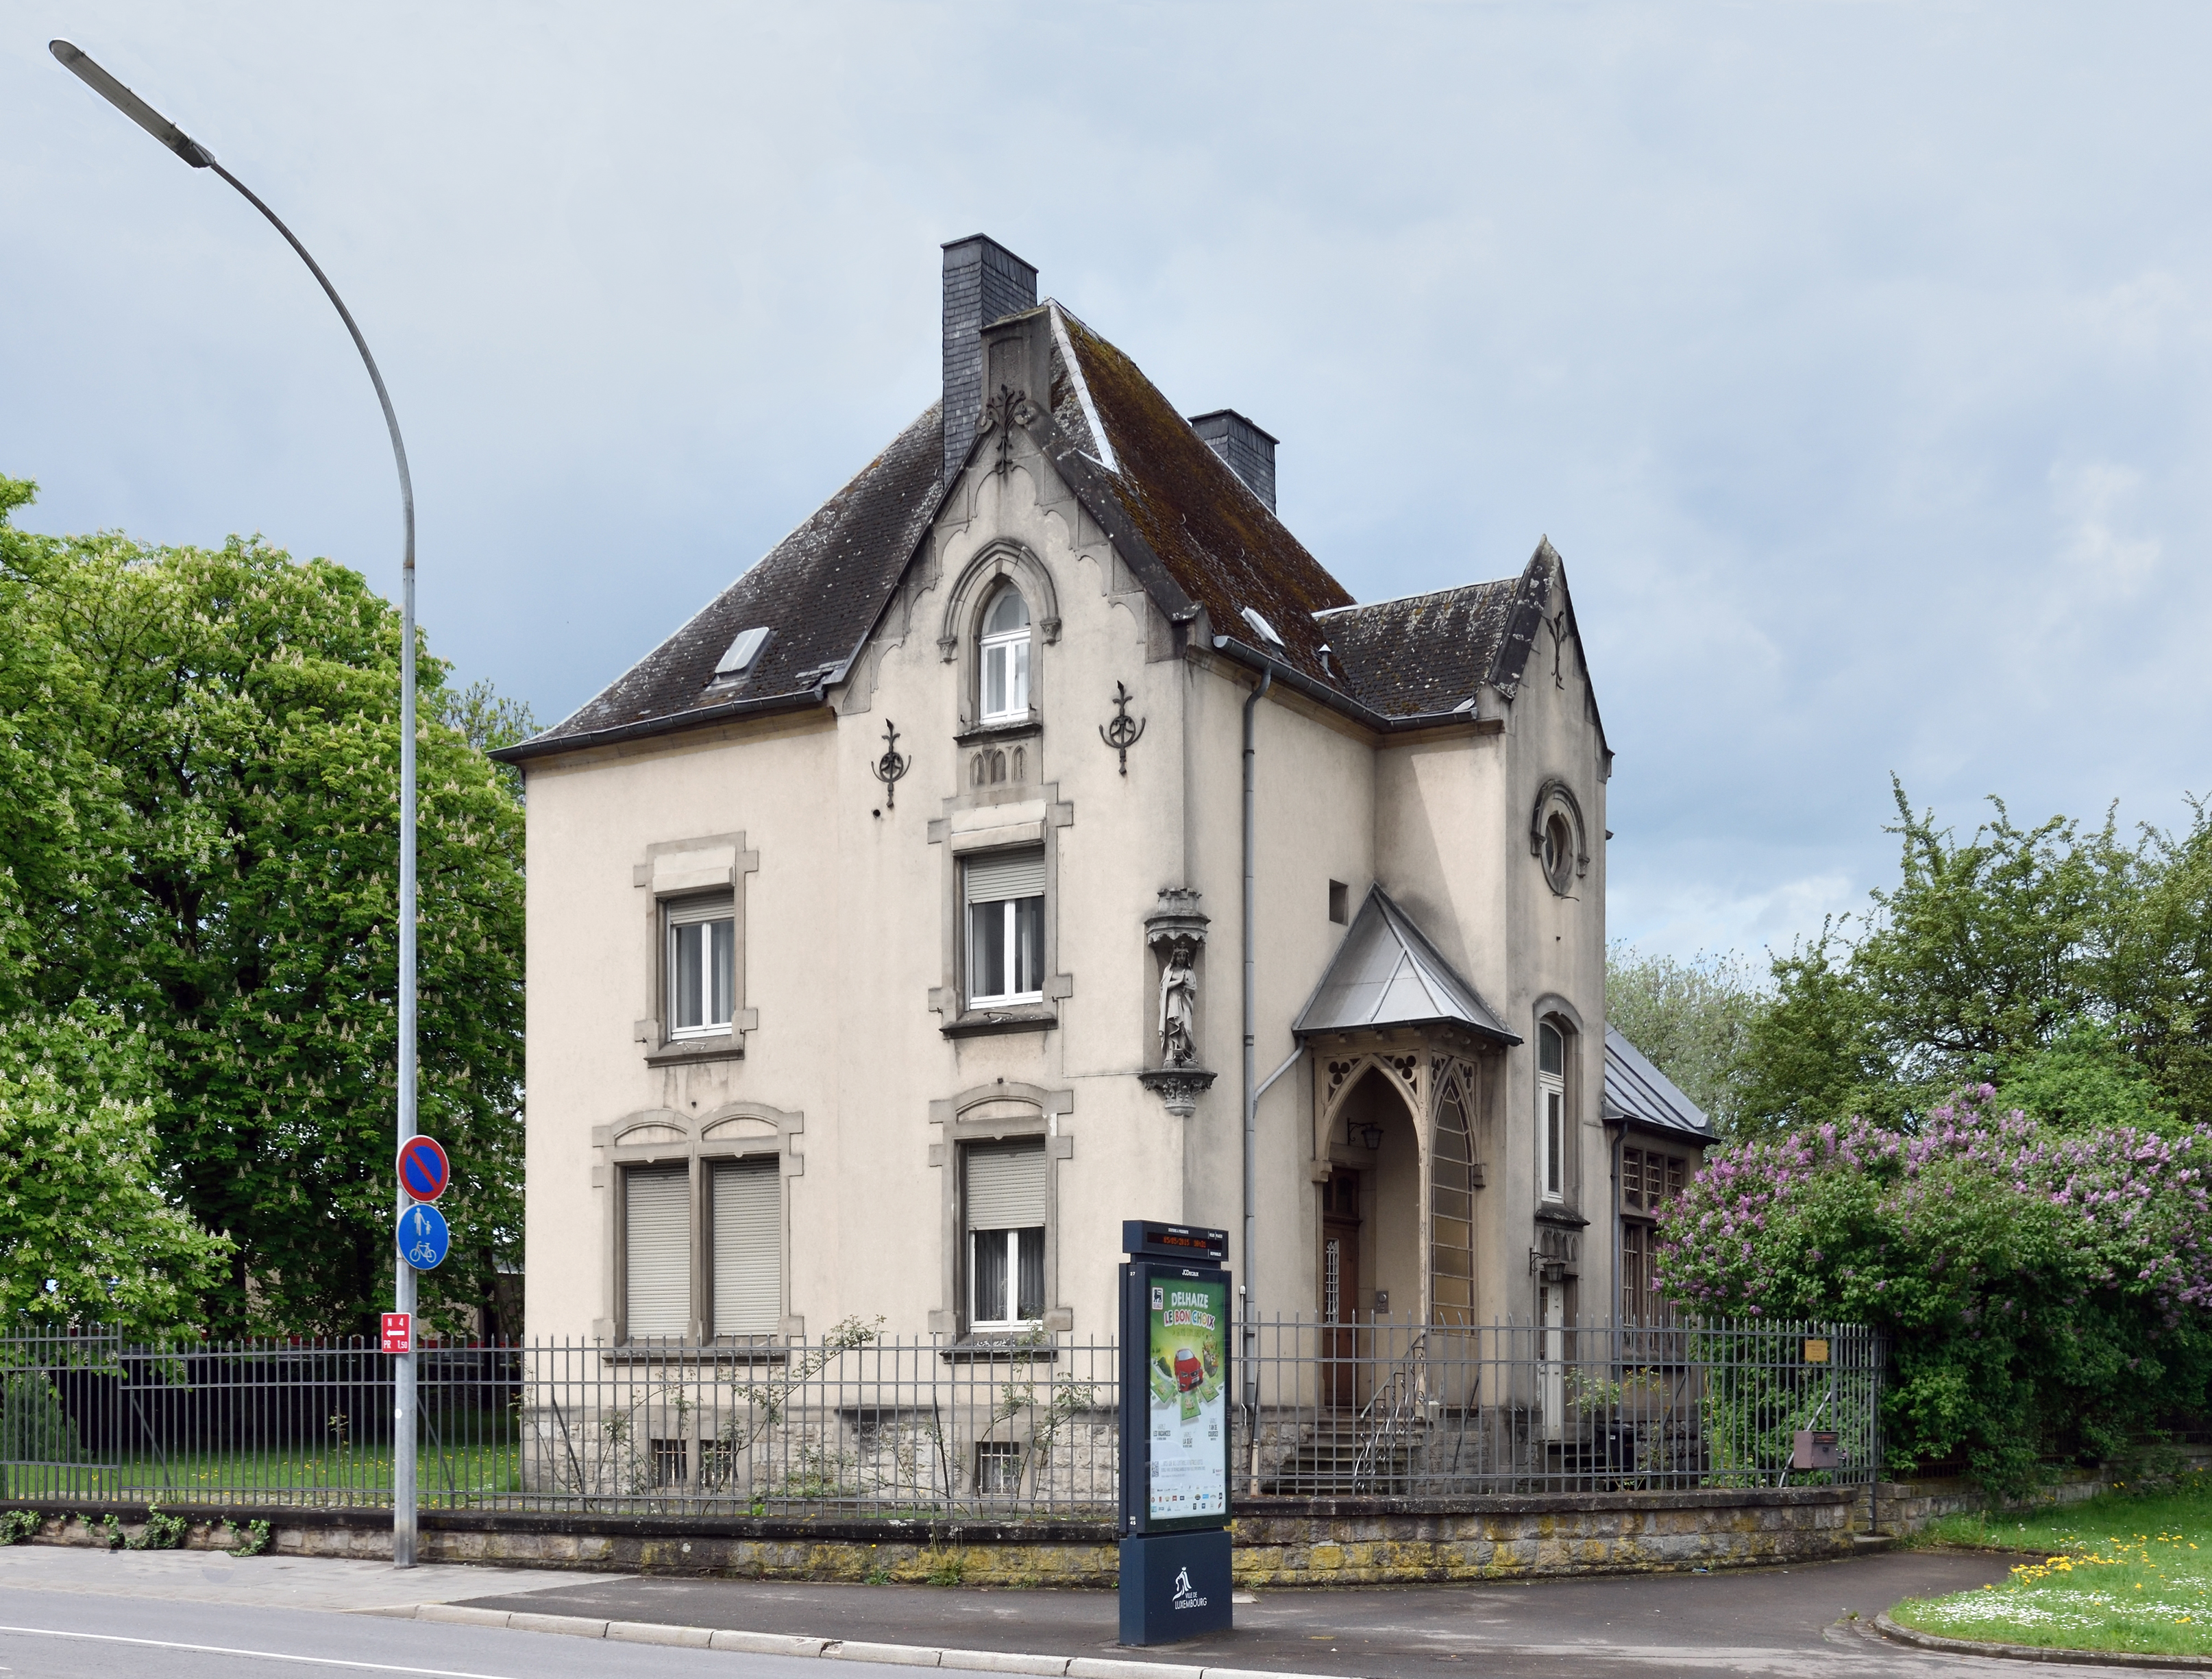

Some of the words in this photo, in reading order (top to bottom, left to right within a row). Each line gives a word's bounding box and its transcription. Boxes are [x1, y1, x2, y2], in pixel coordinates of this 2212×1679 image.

[1171, 1292, 1208, 1309] DELHAIZE
[388, 1318, 393, 1327] N
[399, 1318, 404, 1327] 4
[1164, 1310, 1172, 1325] LE
[1175, 1310, 1190, 1325] BON
[1192, 1311, 1215, 1329] CHOIX
[384, 1340, 391, 1349] PR
[1175, 1597, 1207, 1609] LUXEMBOURG
